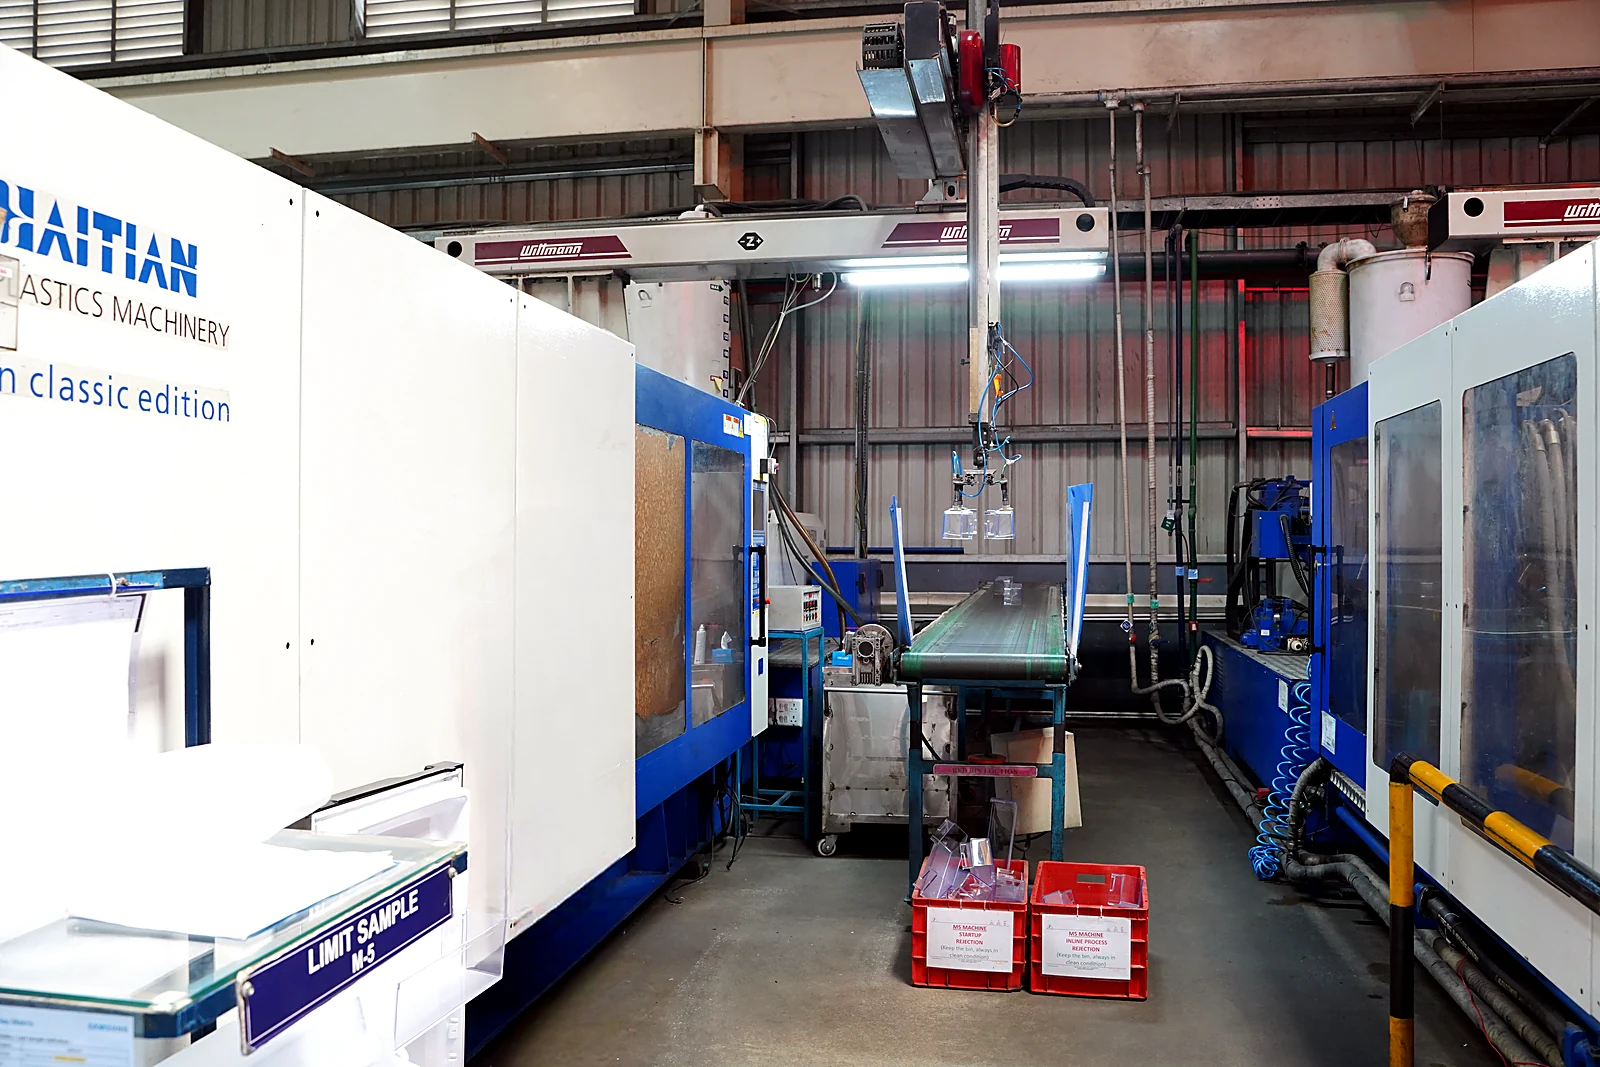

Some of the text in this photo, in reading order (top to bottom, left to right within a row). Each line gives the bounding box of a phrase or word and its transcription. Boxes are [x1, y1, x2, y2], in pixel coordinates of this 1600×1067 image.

[1564, 203, 1600, 217] Witt
[520, 242, 583, 256] Wittmann
[113, 295, 230, 347] MACHINERY
[30, 364, 129, 409] classic
[138, 384, 230, 422] edition
[307, 889, 419, 975] LIMIT SAMPLE
[351, 943, 376, 973] M-5
